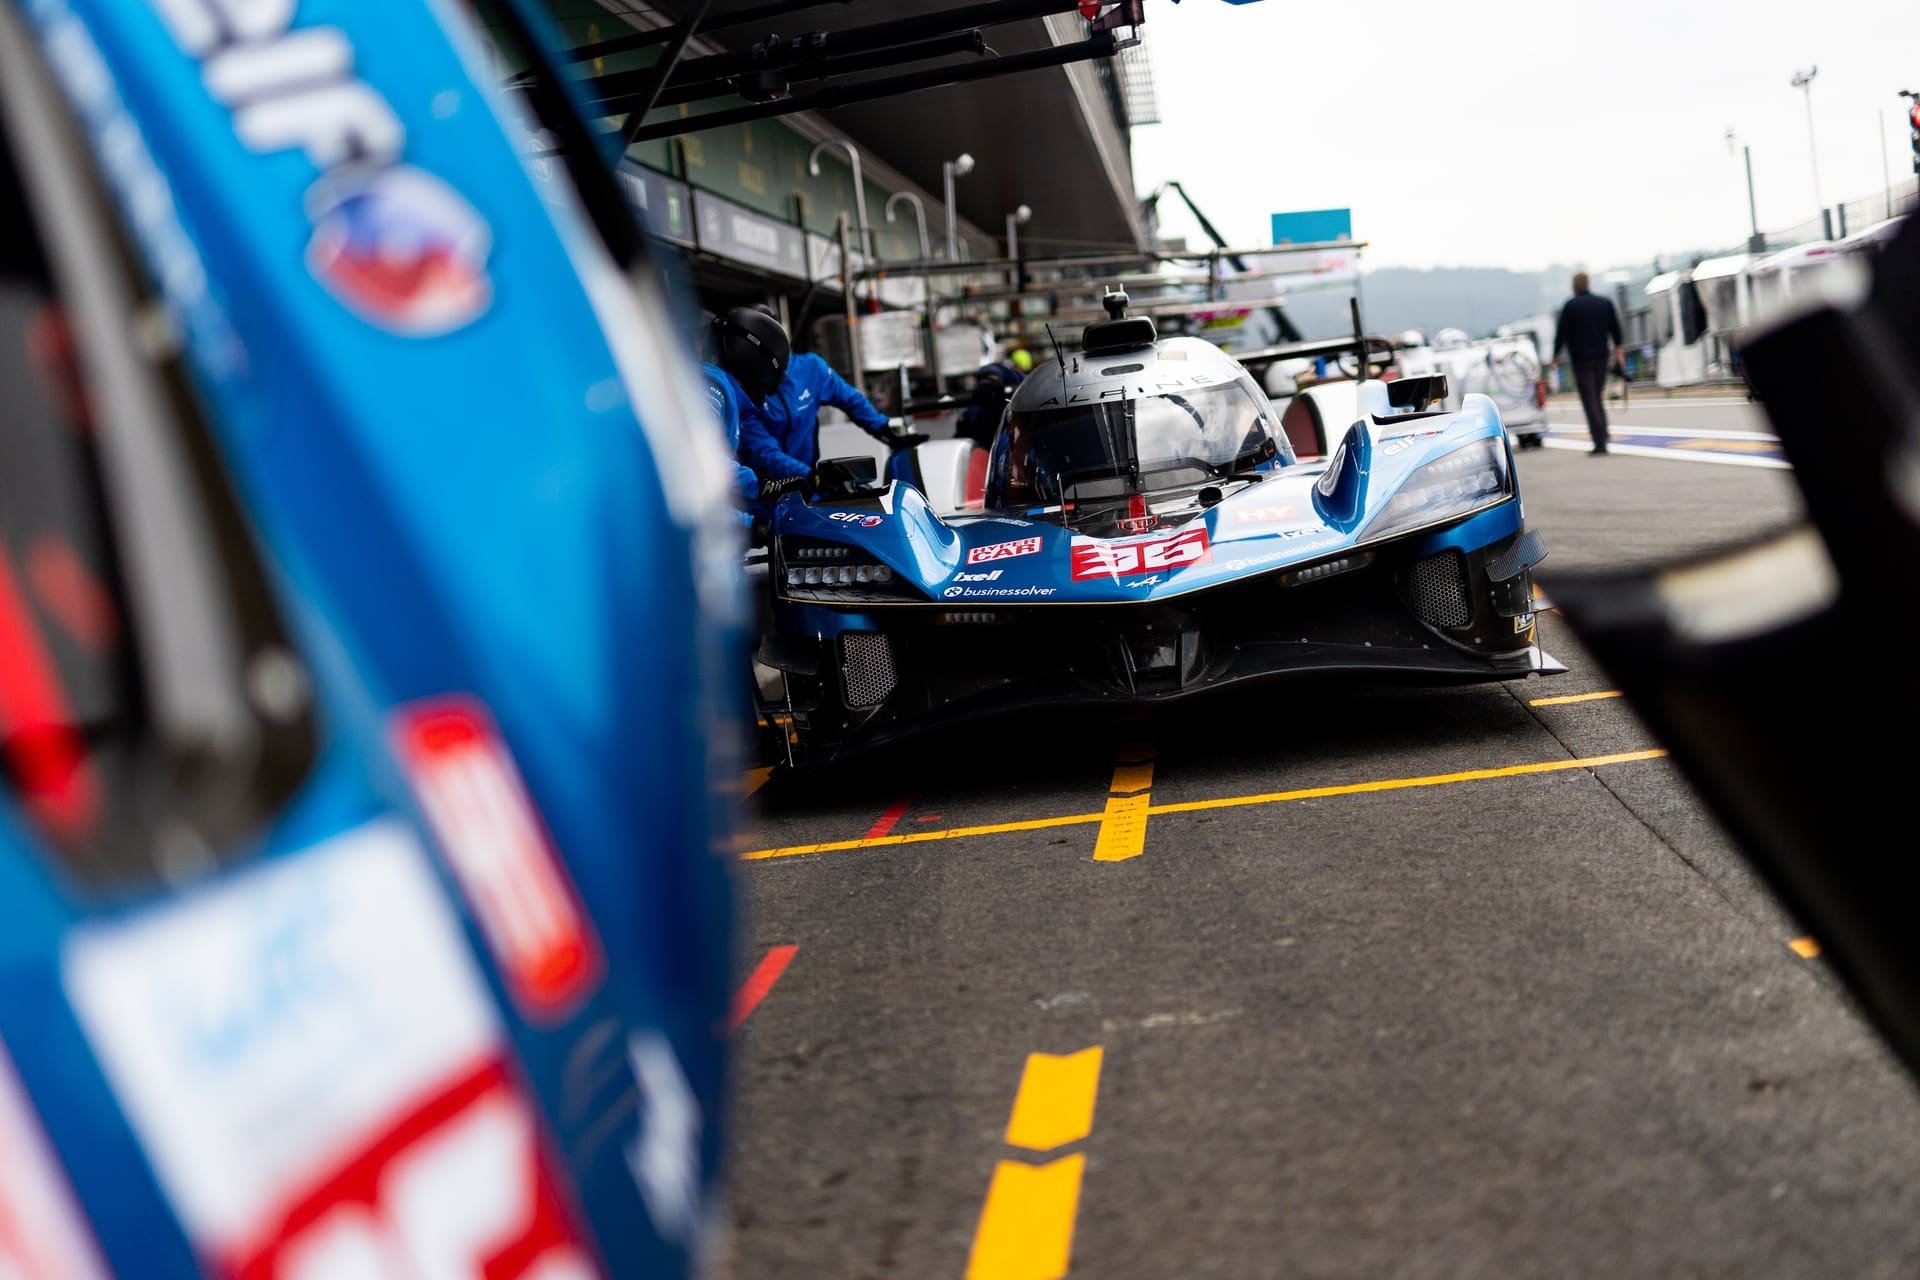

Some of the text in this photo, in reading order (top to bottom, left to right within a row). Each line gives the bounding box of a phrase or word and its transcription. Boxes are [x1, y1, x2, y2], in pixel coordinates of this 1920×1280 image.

[1039, 375, 1214, 407] ALPINE
[829, 512, 866, 522] elf
[972, 544, 1036, 562] CAR
[973, 539, 1036, 554] HYPER
[1076, 531, 1204, 577] 36
[952, 570, 1004, 582] ixell
[964, 585, 1057, 597] businessolver
